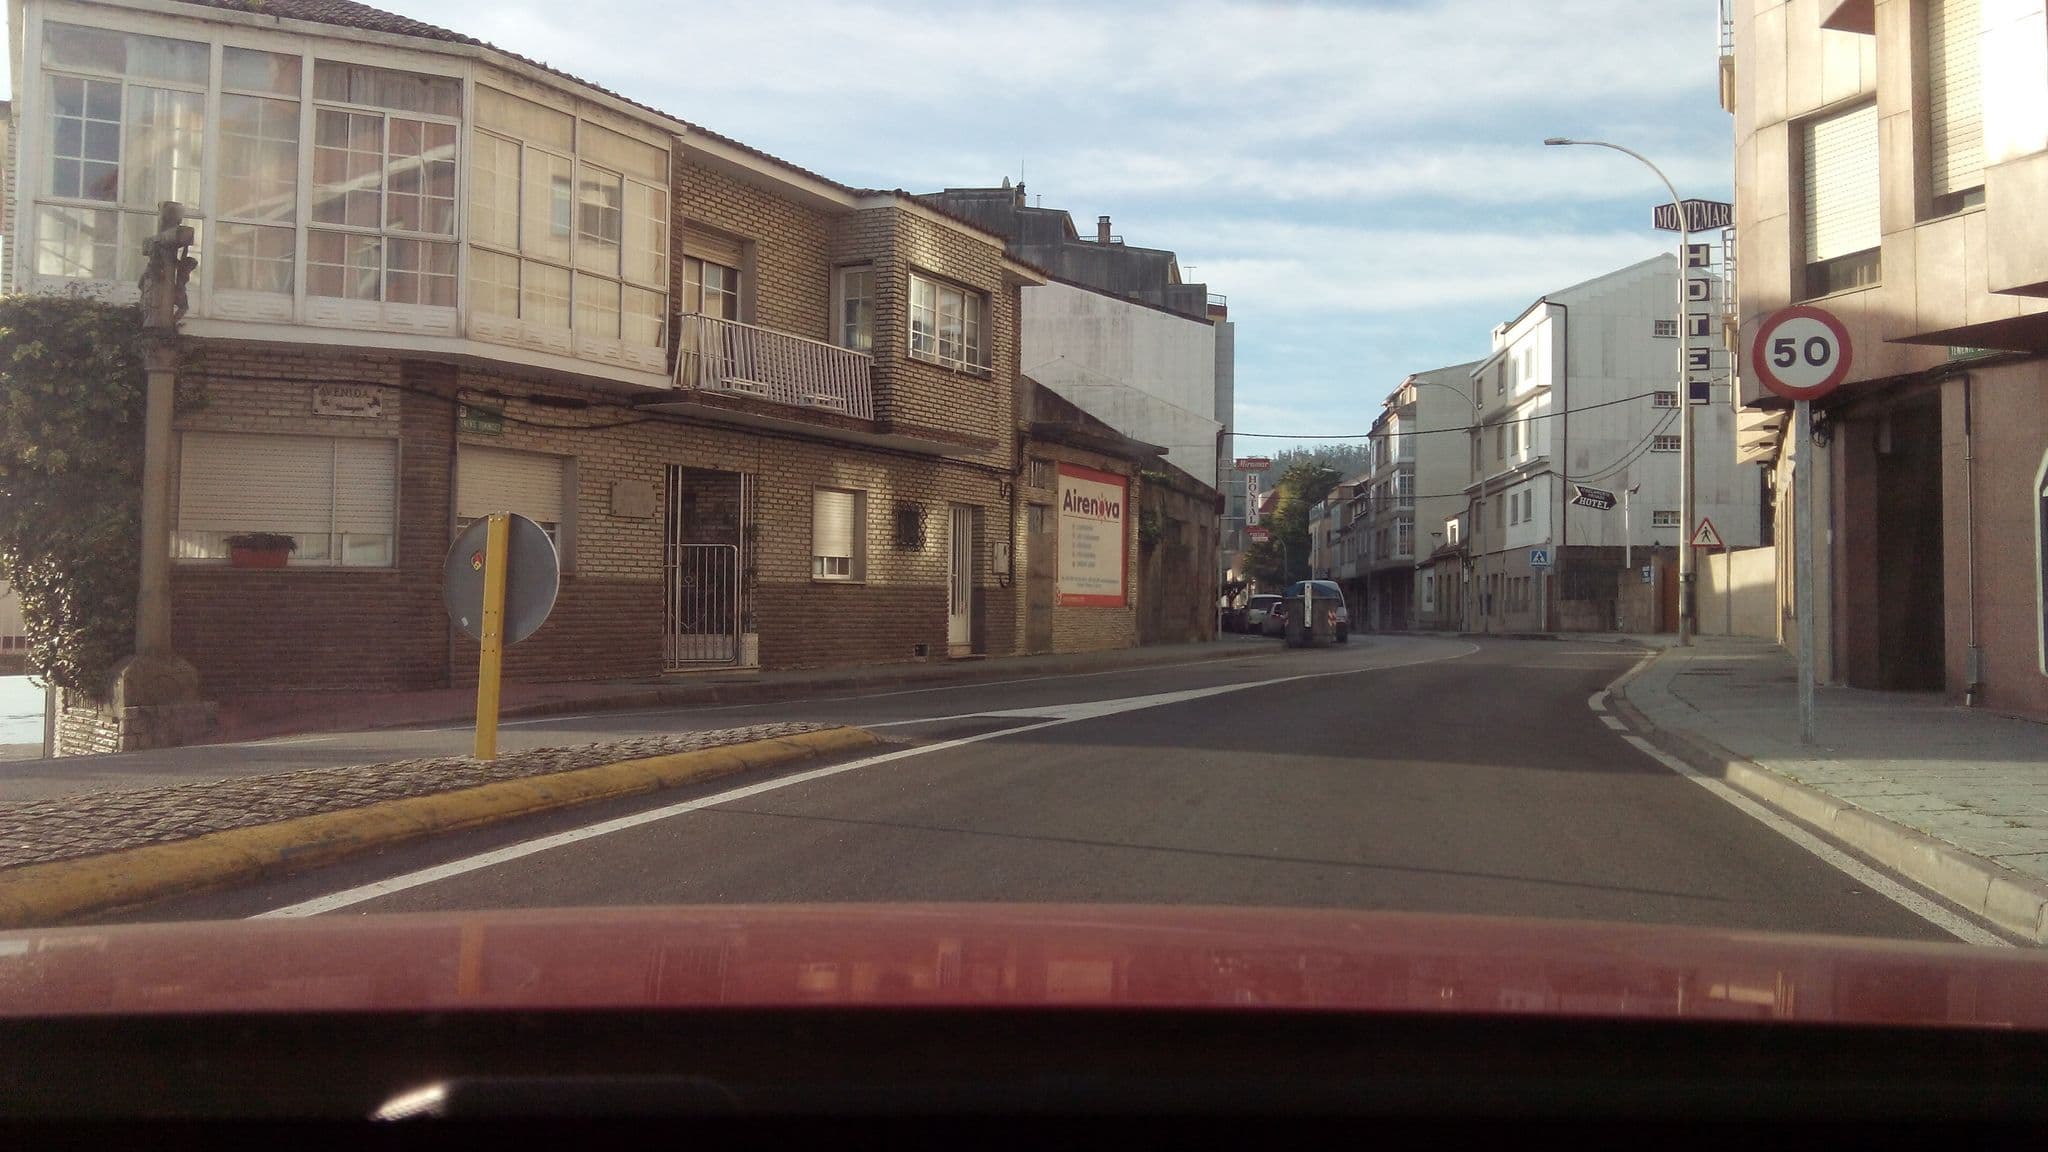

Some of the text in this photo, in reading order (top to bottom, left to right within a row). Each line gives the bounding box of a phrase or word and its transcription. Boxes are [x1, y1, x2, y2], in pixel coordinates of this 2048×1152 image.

[1773, 336, 1831, 368] 50
[1063, 488, 1120, 519] Airenova
[1248, 475, 1257, 524] HOSTAL
[1579, 496, 1609, 510] HOTEL
